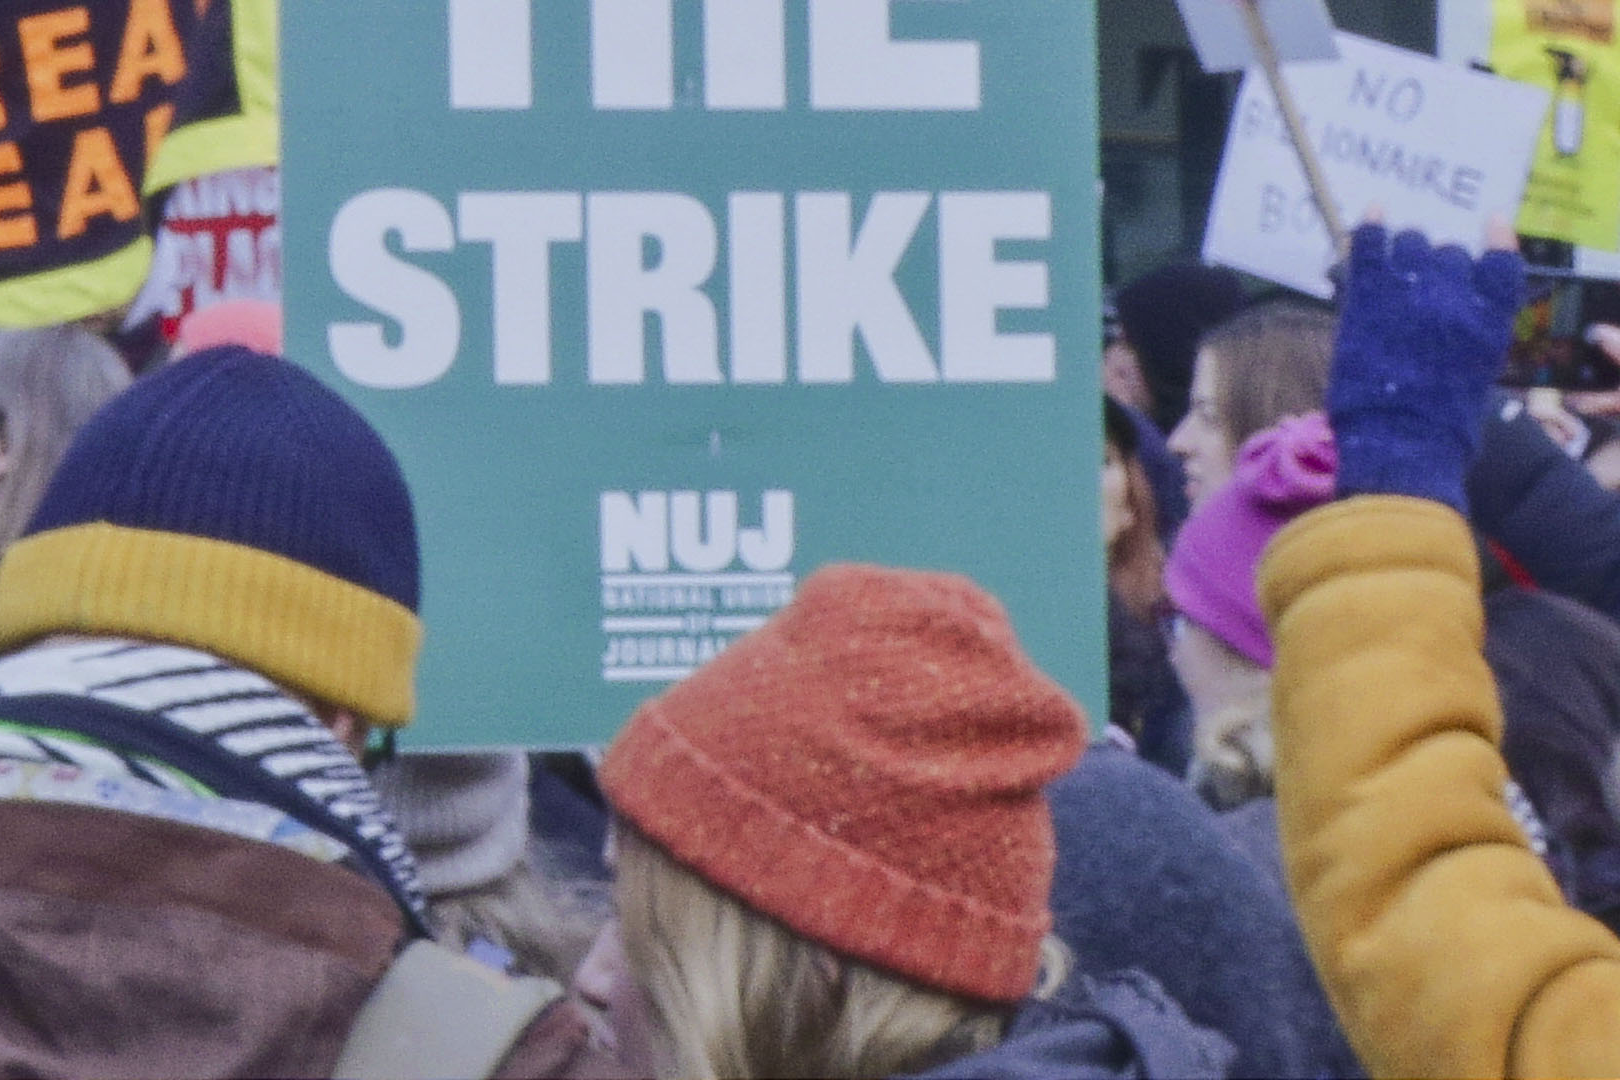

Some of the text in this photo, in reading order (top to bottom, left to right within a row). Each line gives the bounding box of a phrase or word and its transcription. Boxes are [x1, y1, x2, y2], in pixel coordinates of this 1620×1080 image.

[1347, 67, 1425, 122] NO
[327, 187, 1056, 389] STRIKE
[600, 488, 794, 571] NUJ
[602, 636, 728, 666] JOURNA
